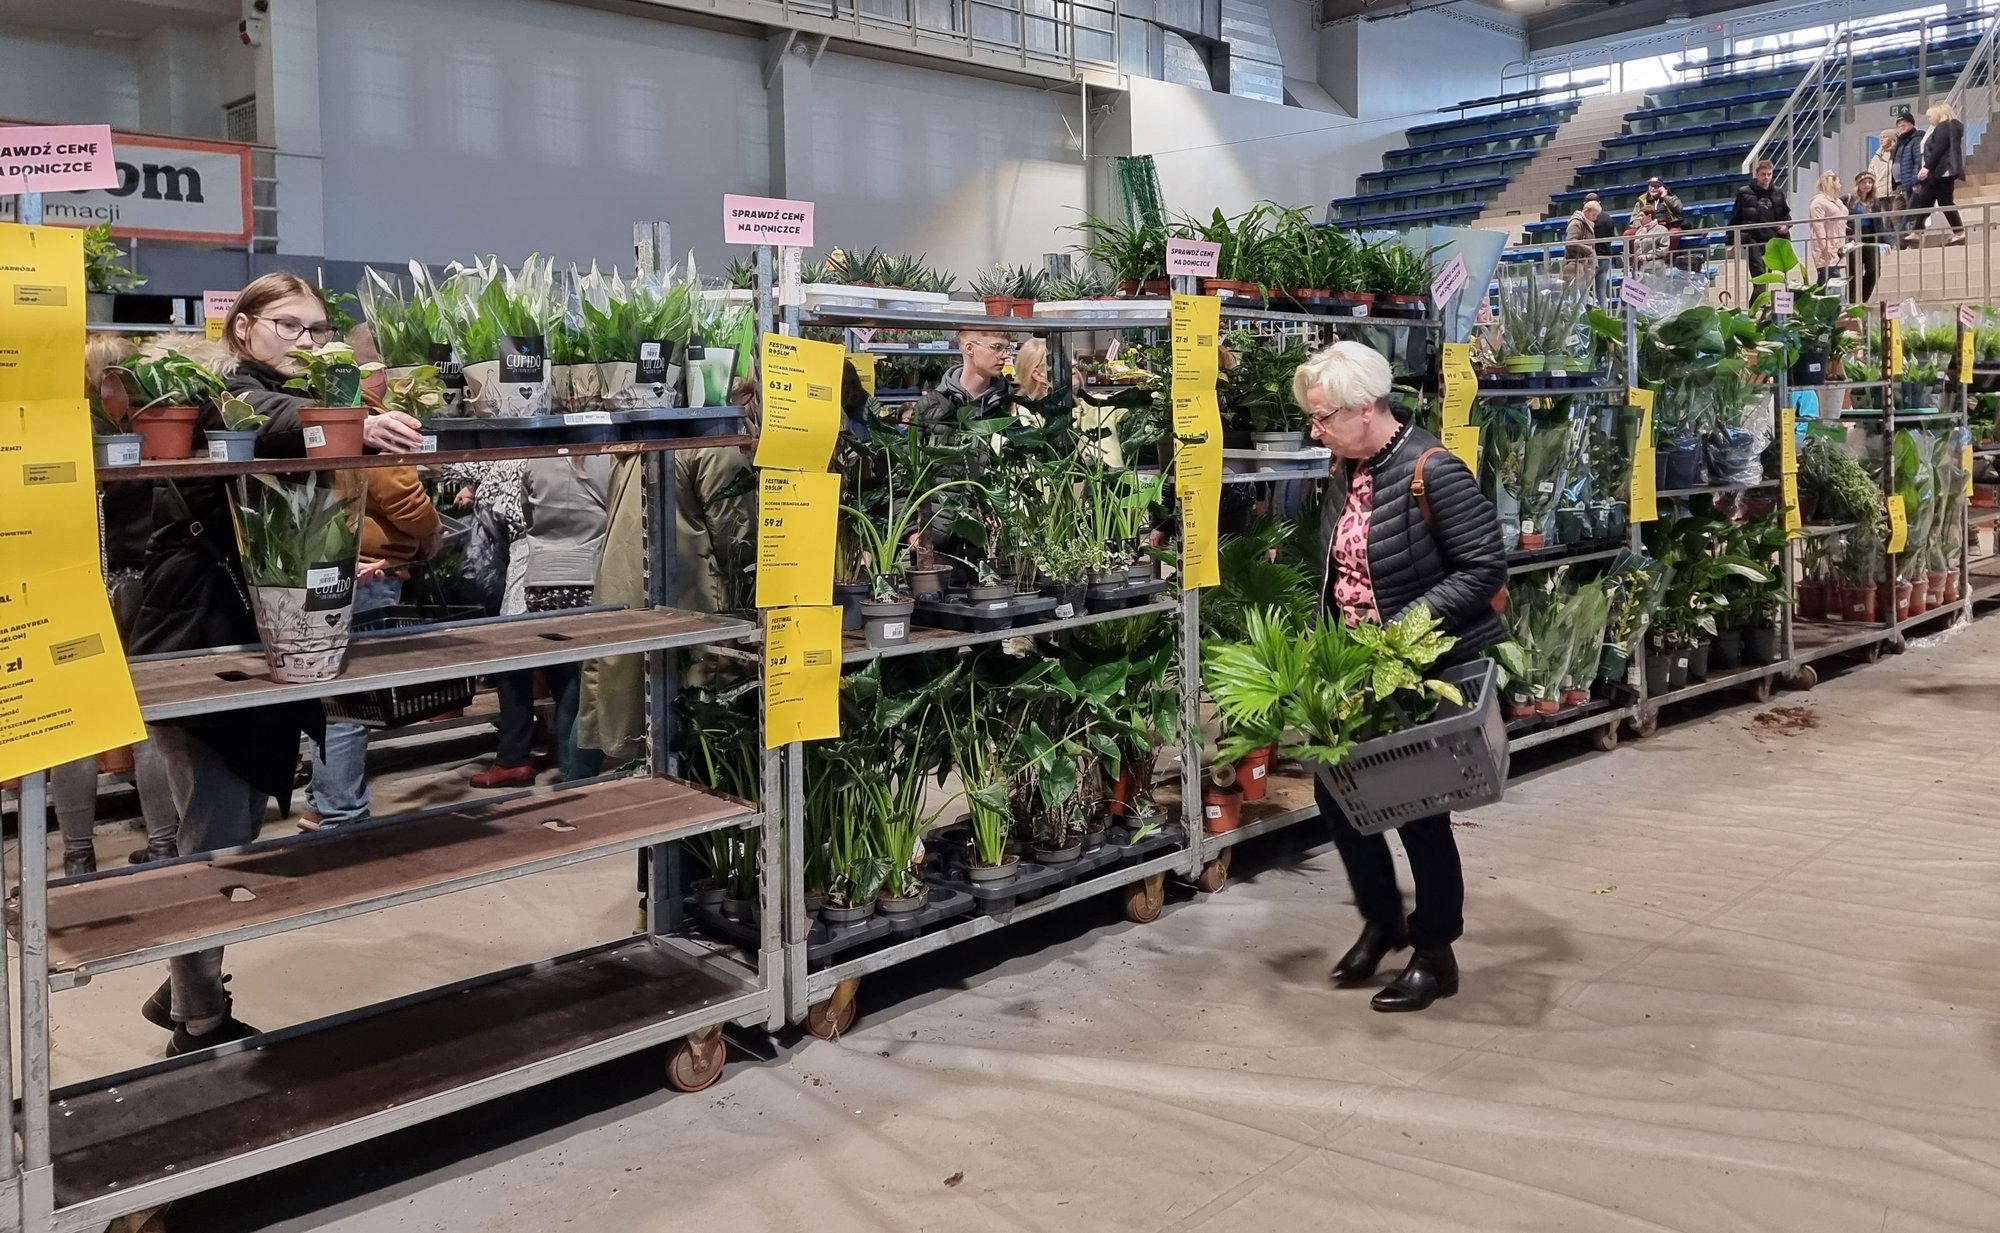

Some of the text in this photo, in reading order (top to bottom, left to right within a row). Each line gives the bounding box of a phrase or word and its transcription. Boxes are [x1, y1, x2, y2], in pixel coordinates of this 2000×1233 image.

[0, 141, 98, 157] AWDŹ CENĘ
[9, 161, 93, 176] DONICZCE
[731, 209, 806, 223] SPRAWDŹ CENĘ
[738, 223, 801, 234] NA DONICZCE
[1171, 247, 1215, 258] SPRAWDŹ CENĘ
[506, 354, 541, 368] CUPIDO
[769, 380, 792, 392] 63 zł
[764, 518, 775, 527] 59
[7, 656, 23, 673] zł
